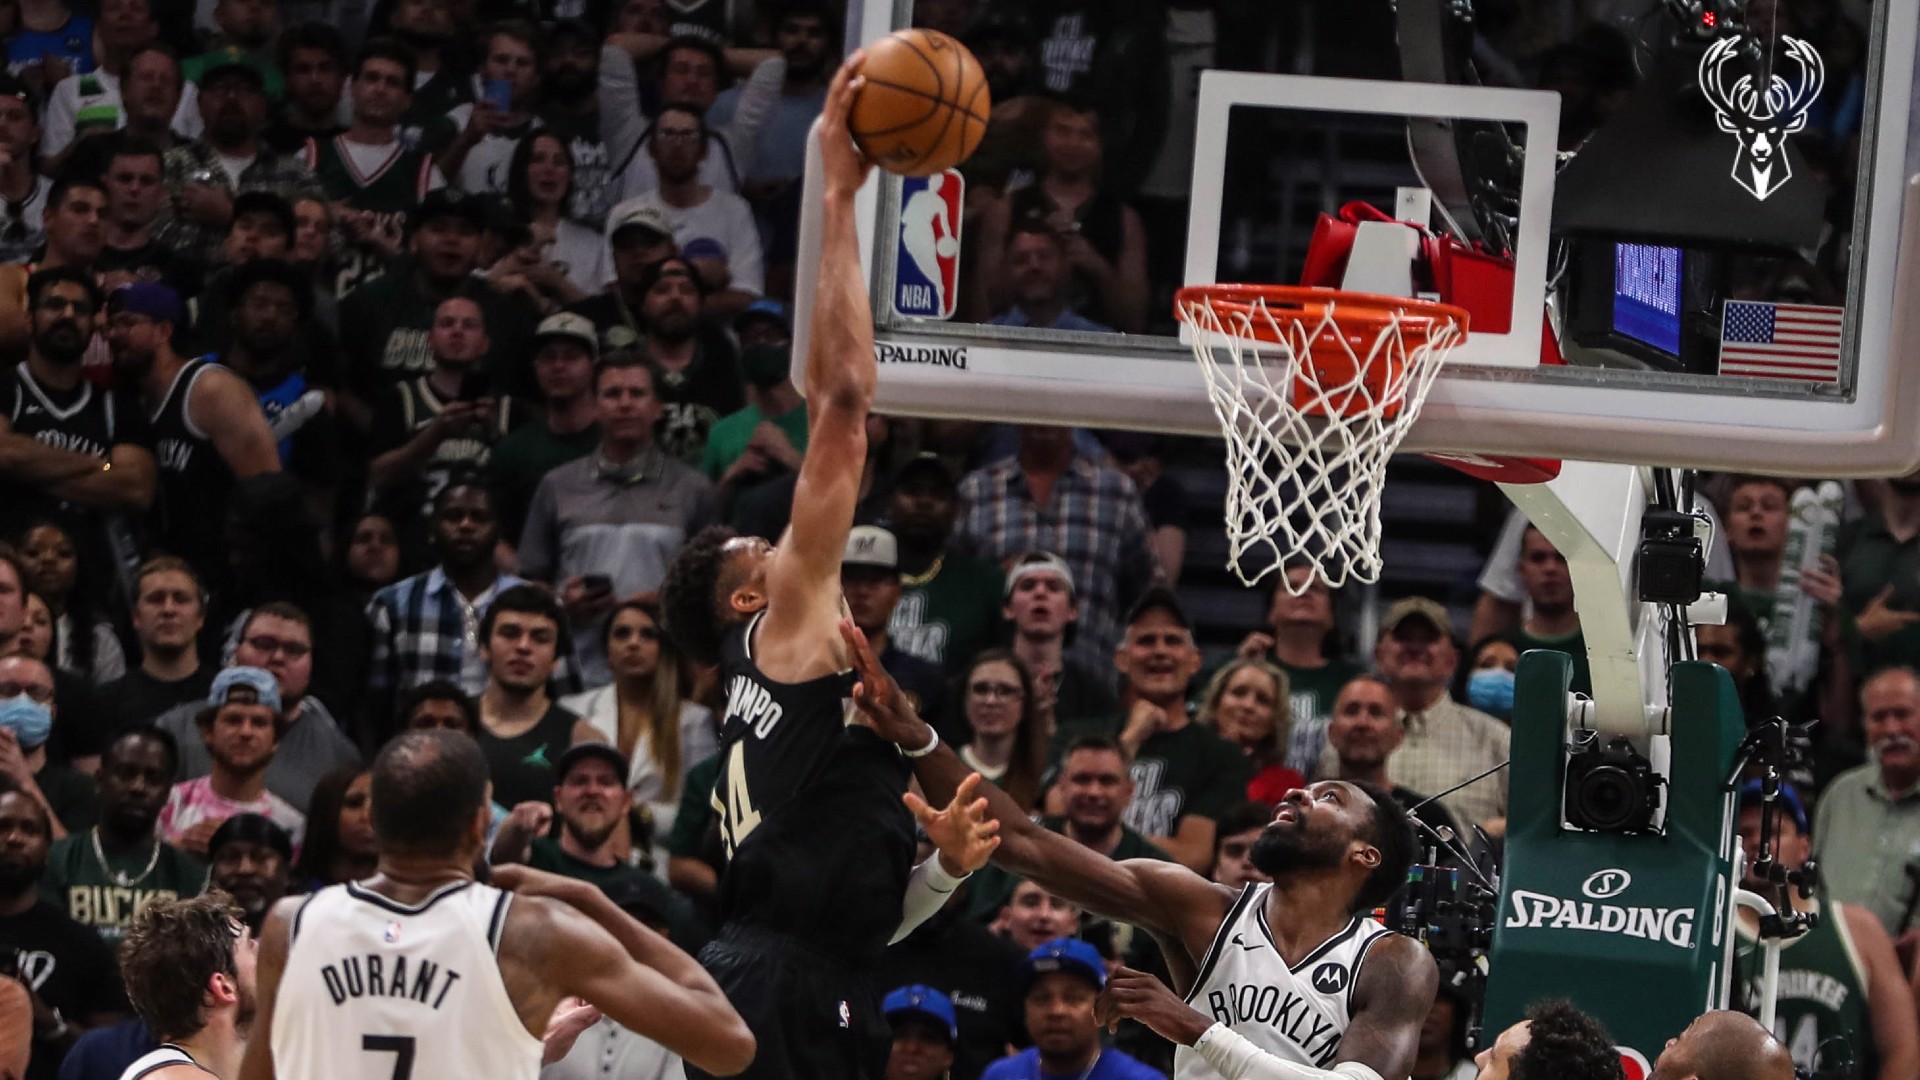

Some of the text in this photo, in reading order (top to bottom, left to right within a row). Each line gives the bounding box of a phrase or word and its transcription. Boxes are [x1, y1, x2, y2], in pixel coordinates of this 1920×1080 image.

[902, 284, 932, 310] NBA
[874, 346, 968, 370] PALDING
[1506, 890, 1696, 948] SPALDING
[321, 953, 461, 1010] DURANT
[1208, 983, 1342, 1068] BROOKLYN
[361, 1033, 416, 1080] 7
